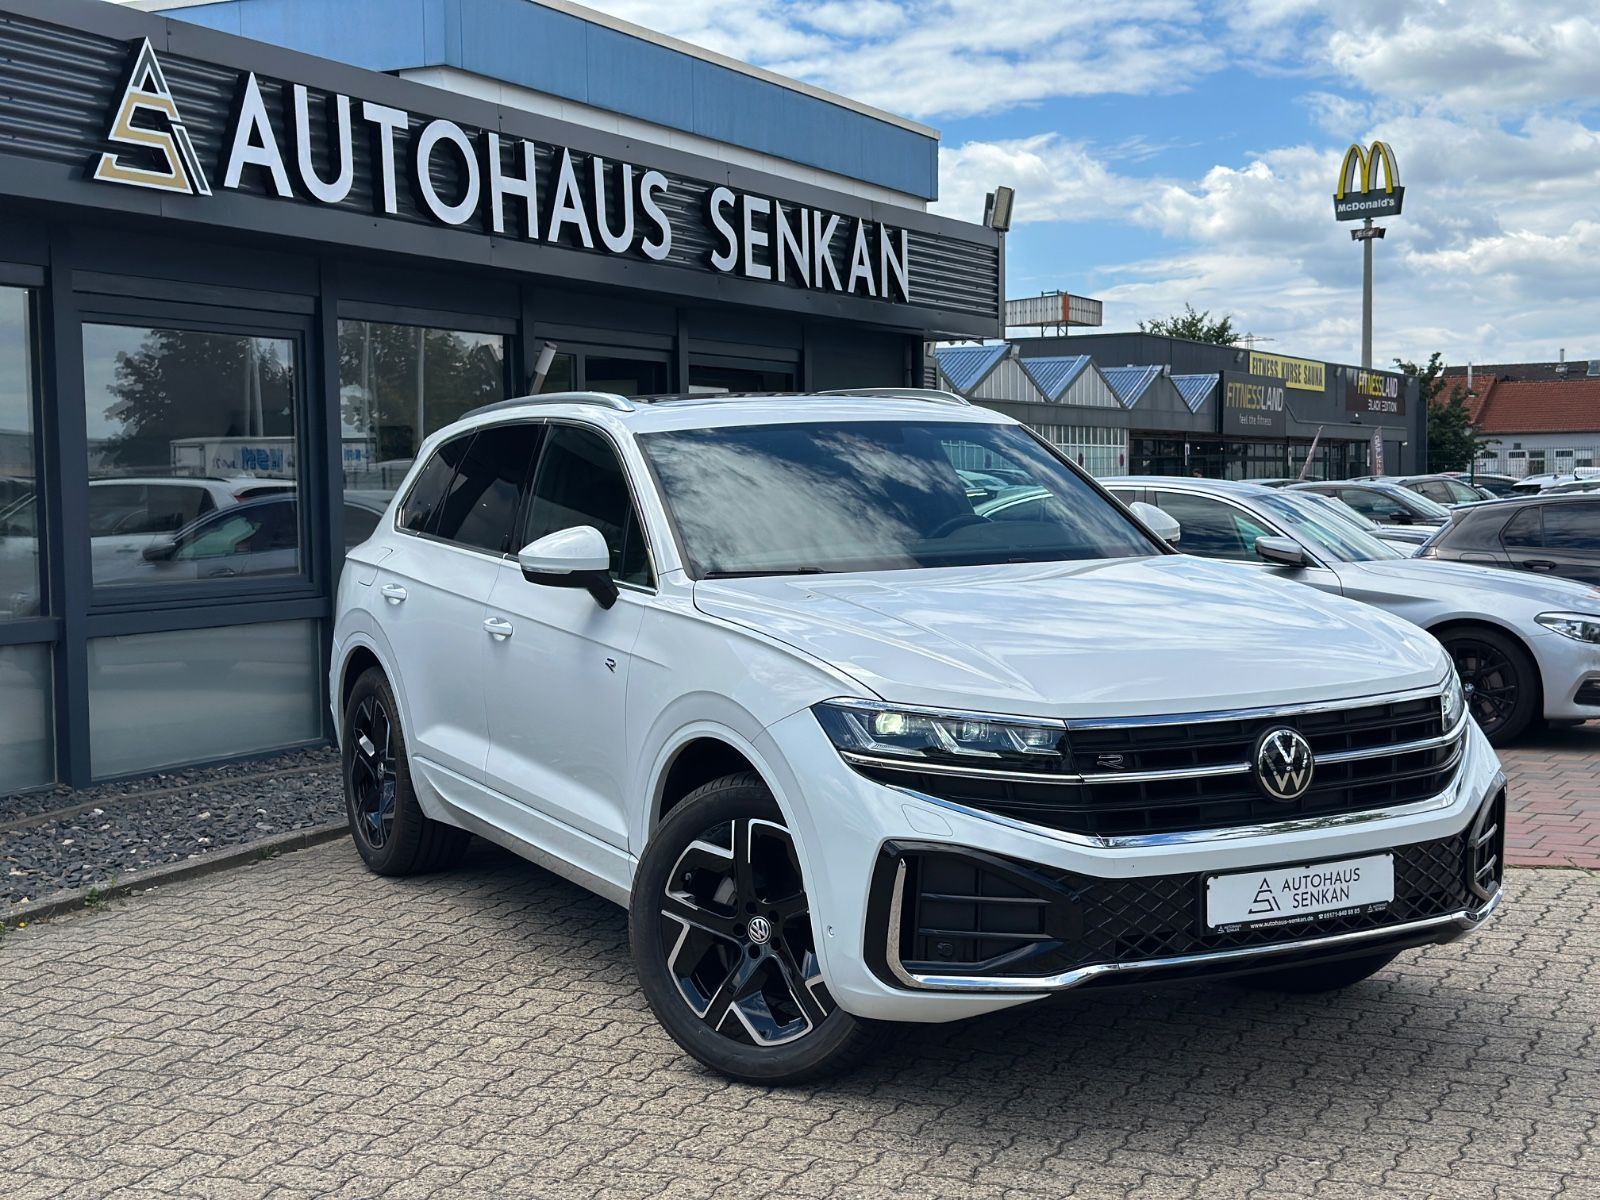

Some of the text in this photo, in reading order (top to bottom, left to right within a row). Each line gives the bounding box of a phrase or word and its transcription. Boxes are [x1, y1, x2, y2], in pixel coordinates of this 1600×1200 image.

[224, 71, 910, 303] AUTOHAUS SENKAN
[1337, 198, 1395, 212] McDonald's
[1252, 356, 1323, 387] FITNESS KURSE SAUNA
[1357, 370, 1398, 398] FITNESSLAND
[1226, 381, 1284, 412] FITNESSLAND
[1281, 867, 1361, 893] AUTOHAUS
[1292, 885, 1350, 909] SENKAN
